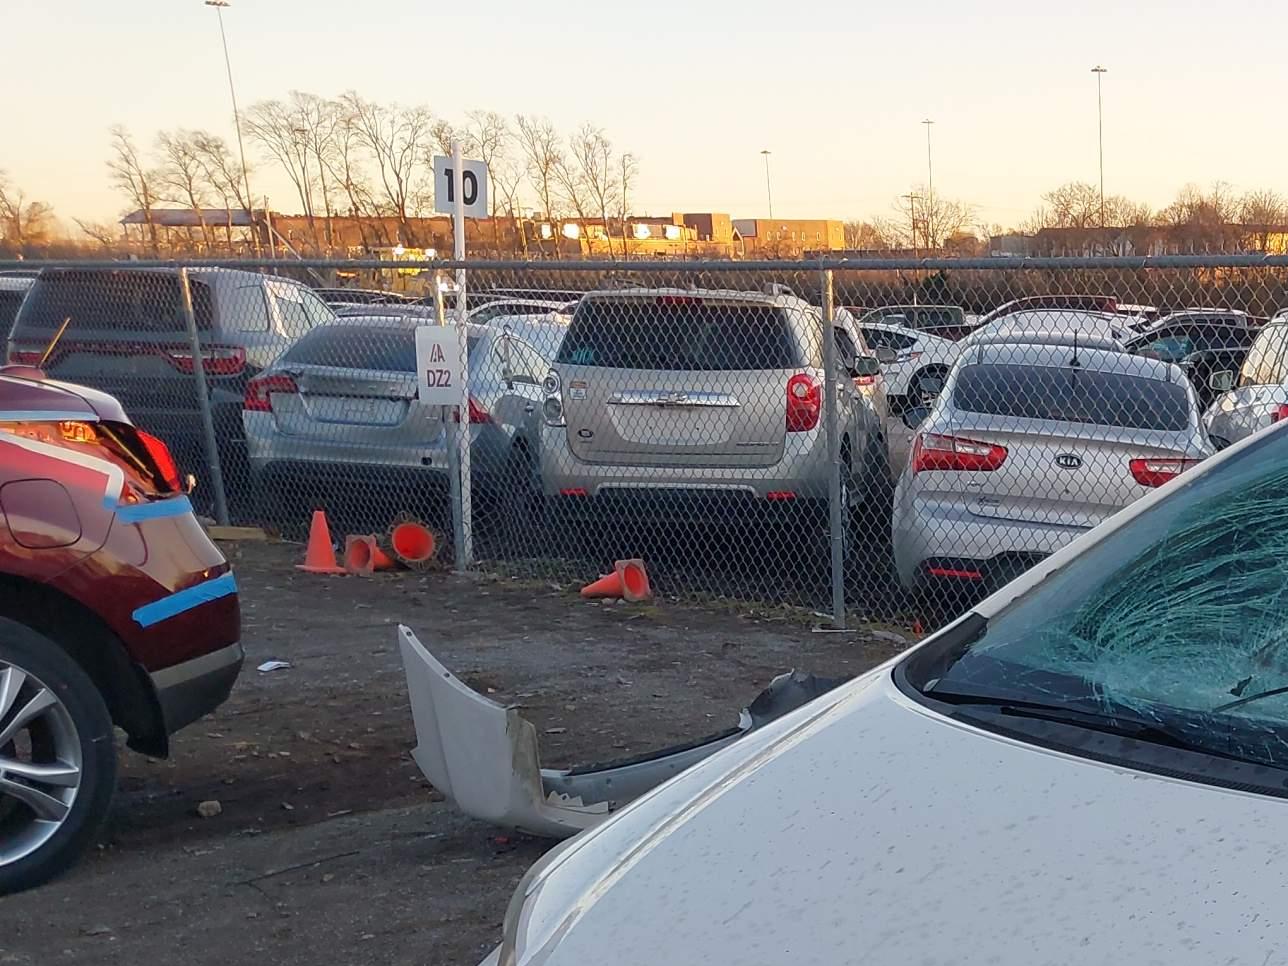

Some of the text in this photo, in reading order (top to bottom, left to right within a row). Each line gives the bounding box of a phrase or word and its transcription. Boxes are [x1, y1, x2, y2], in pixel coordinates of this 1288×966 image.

[444, 168, 478, 206] 10
[427, 369, 452, 388] DZ2
[1059, 456, 1079, 466] KIA
